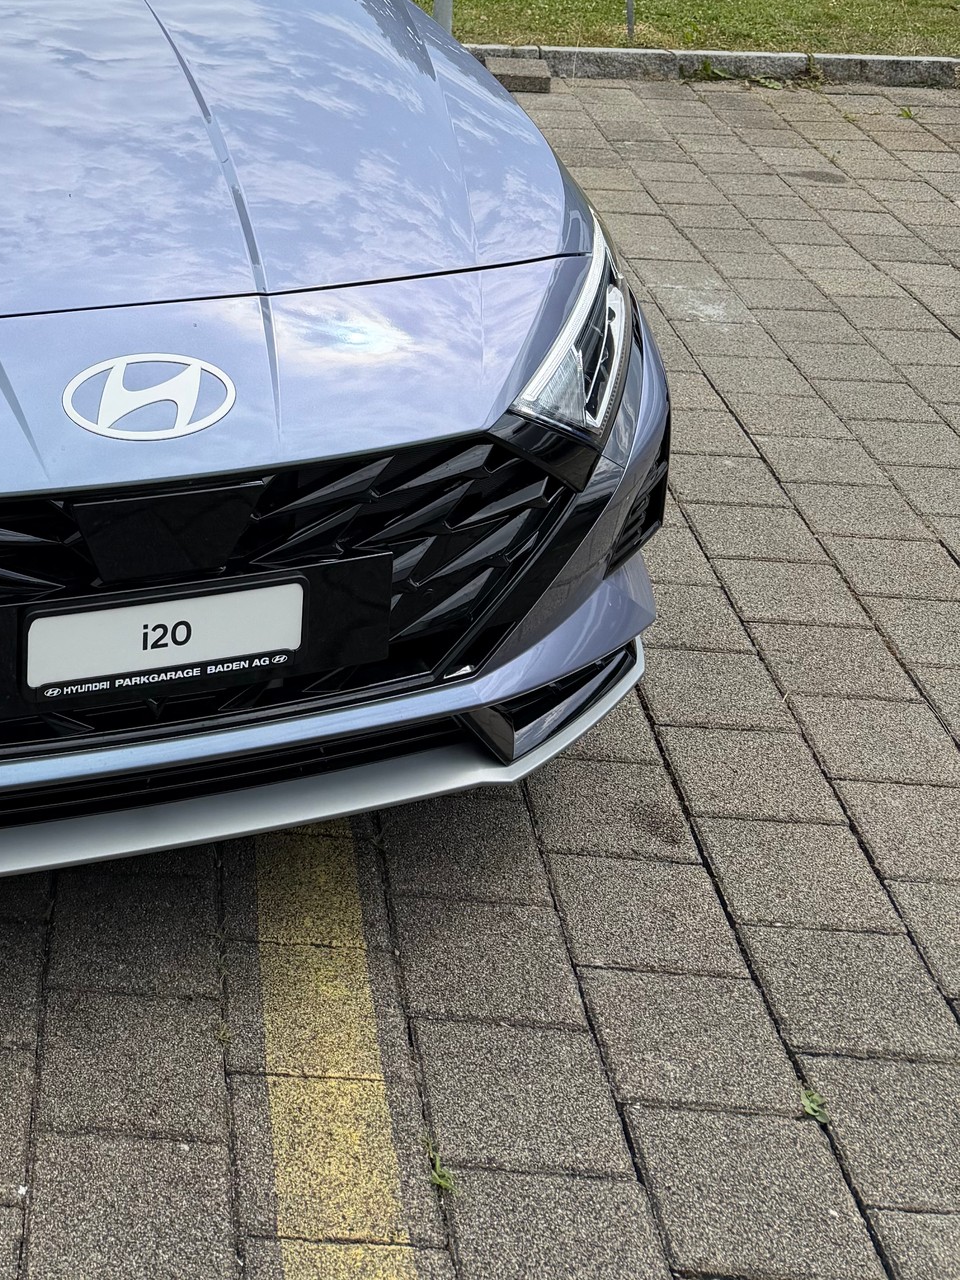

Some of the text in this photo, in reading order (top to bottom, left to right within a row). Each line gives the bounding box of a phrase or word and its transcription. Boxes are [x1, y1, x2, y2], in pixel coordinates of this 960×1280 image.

[142, 620, 192, 651] i20
[63, 656, 270, 696] HYUNDAI PARKGARAGE BADEN AG
